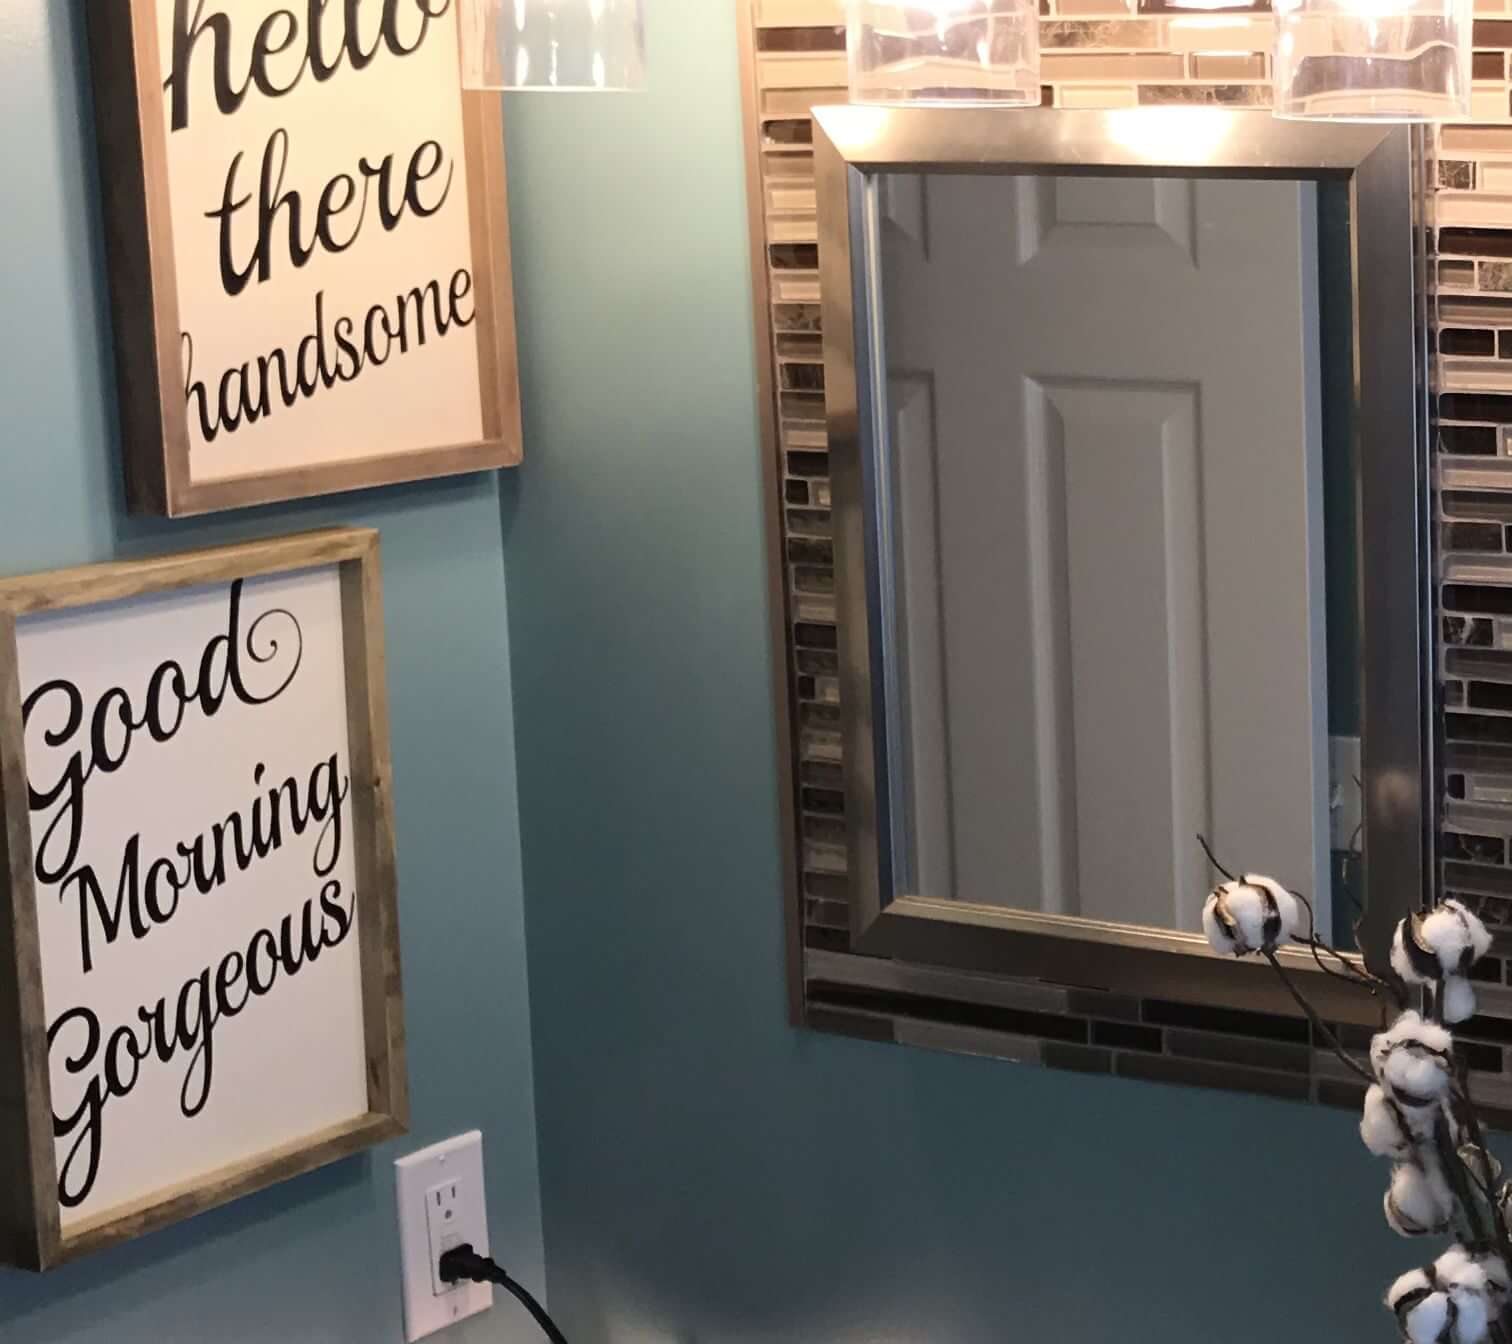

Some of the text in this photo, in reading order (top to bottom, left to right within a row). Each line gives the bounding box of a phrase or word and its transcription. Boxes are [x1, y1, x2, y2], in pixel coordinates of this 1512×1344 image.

[203, 127, 454, 297] there
[180, 268, 476, 442] handsome
[22, 577, 303, 884] Good
[59, 751, 349, 974] Morning
[46, 878, 356, 1208] Gorgeous
